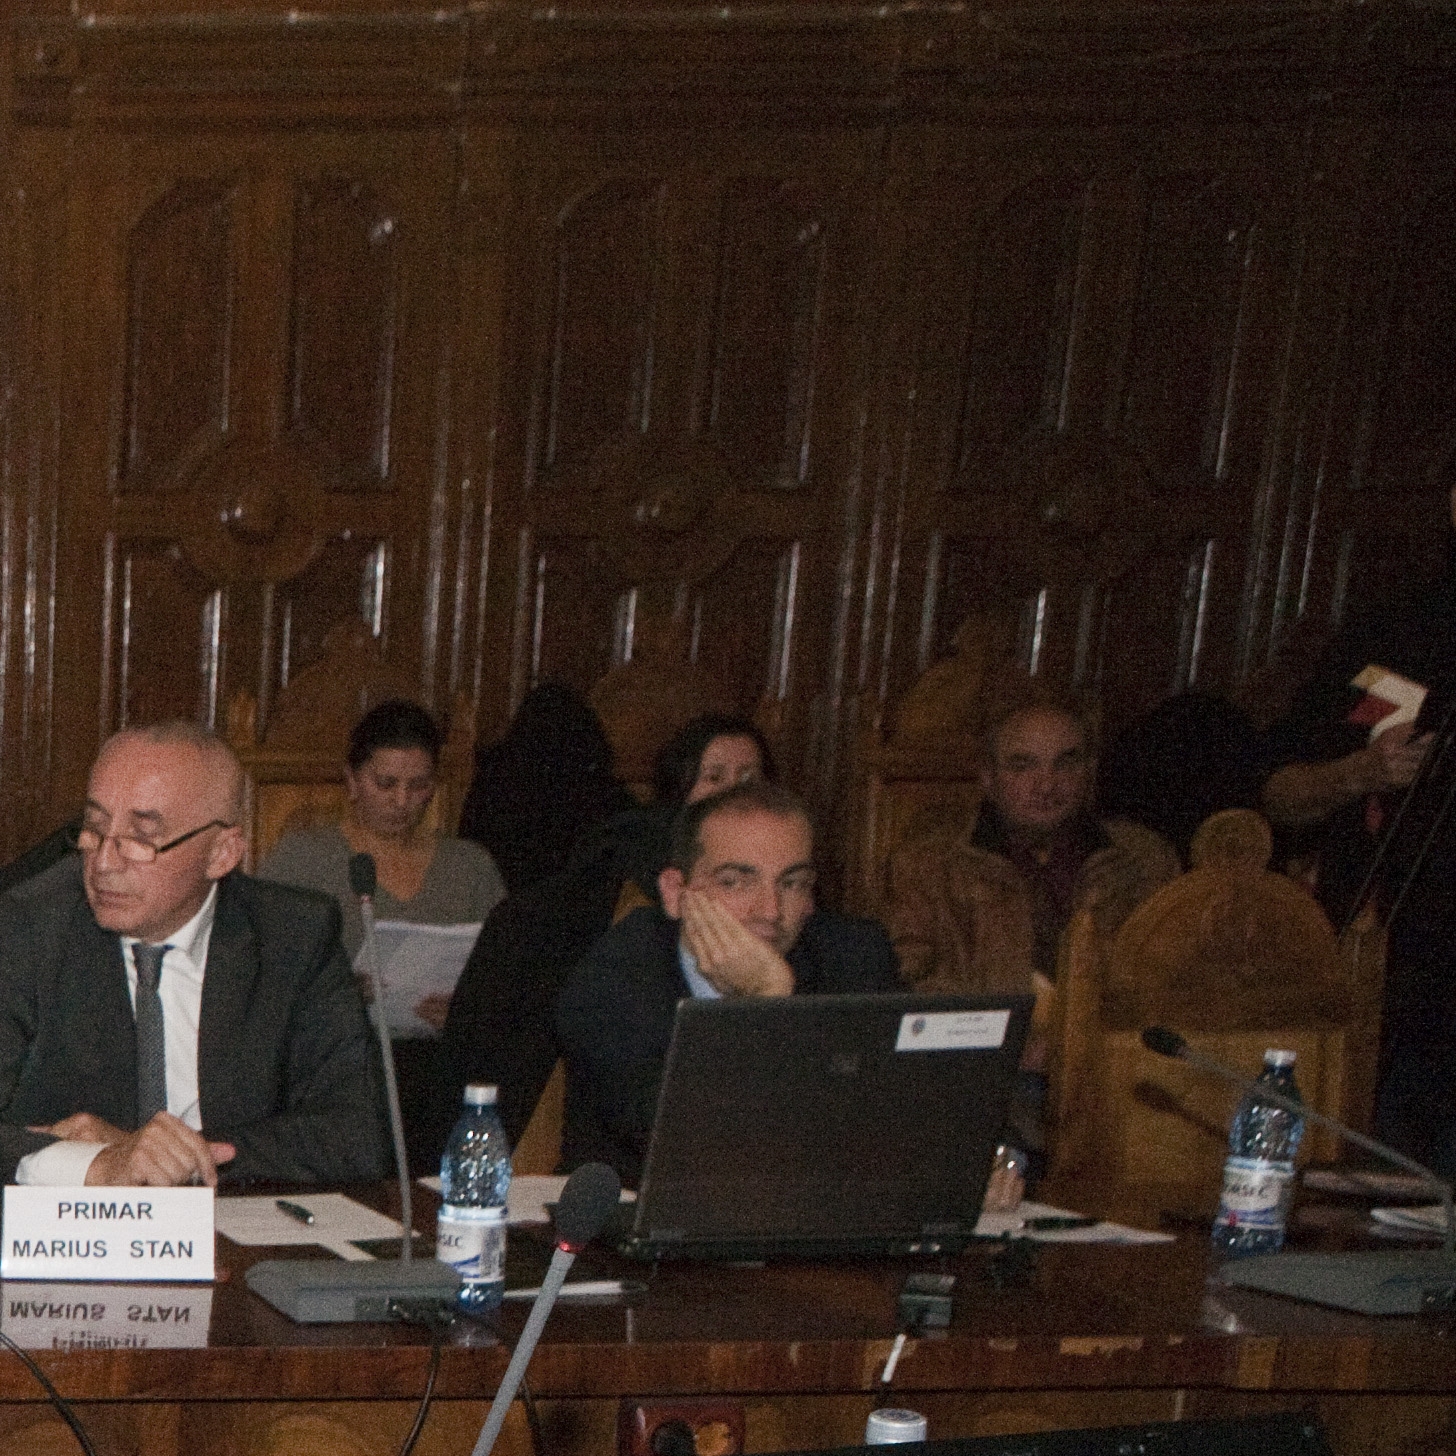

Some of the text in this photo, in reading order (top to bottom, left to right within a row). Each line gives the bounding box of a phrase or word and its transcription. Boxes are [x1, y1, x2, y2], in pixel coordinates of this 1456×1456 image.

[57, 1201, 153, 1221] PRIMAR
[12, 1238, 194, 1259] MARIUS STAN
